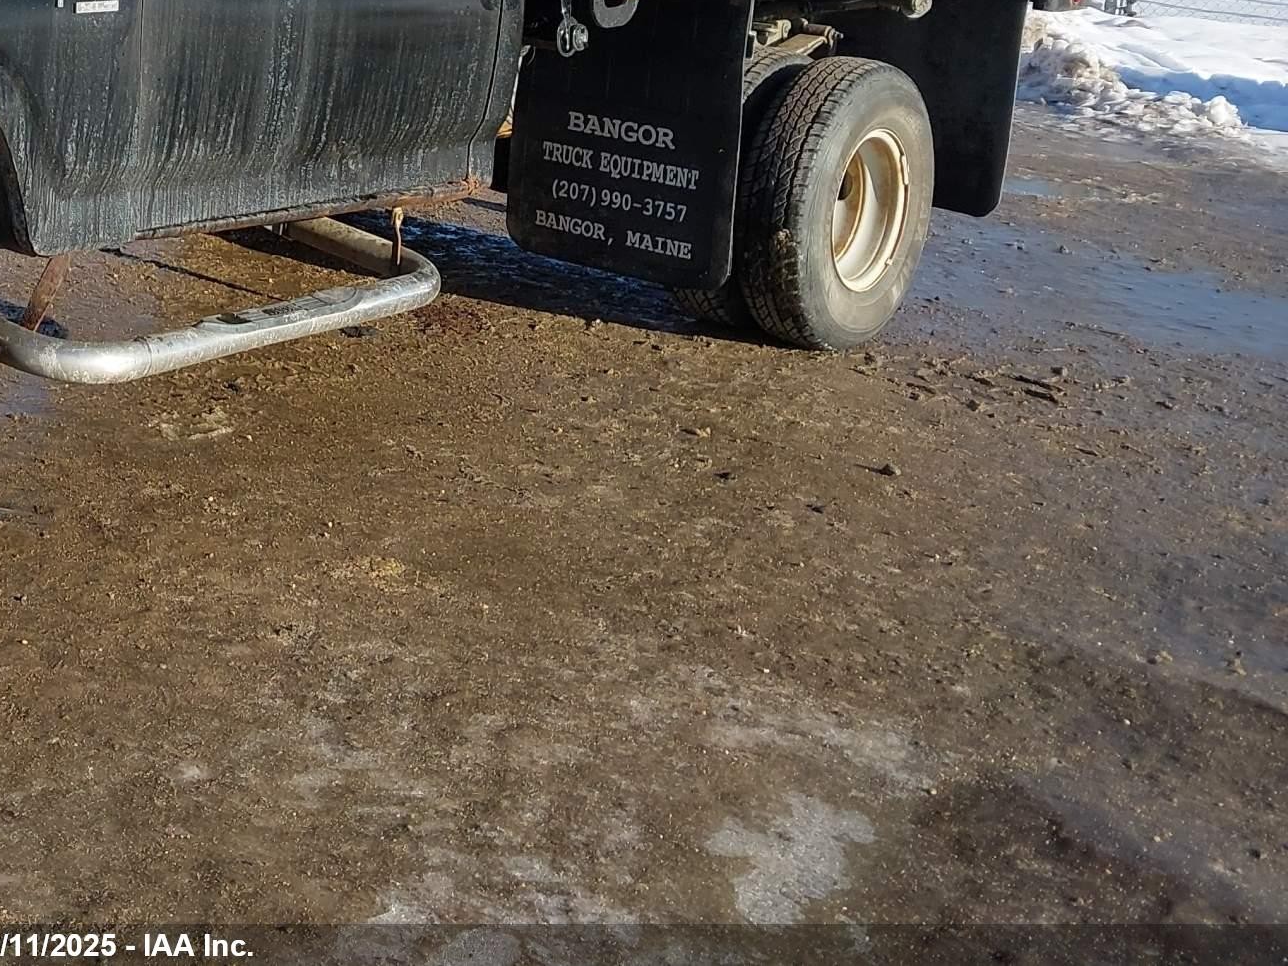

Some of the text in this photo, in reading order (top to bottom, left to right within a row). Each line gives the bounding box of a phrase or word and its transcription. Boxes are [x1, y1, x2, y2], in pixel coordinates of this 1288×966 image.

[567, 111, 676, 150] BANGOR
[542, 141, 700, 190] TRUCK EQUIPMENT
[535, 209, 693, 260] BANGOR, MAINE
